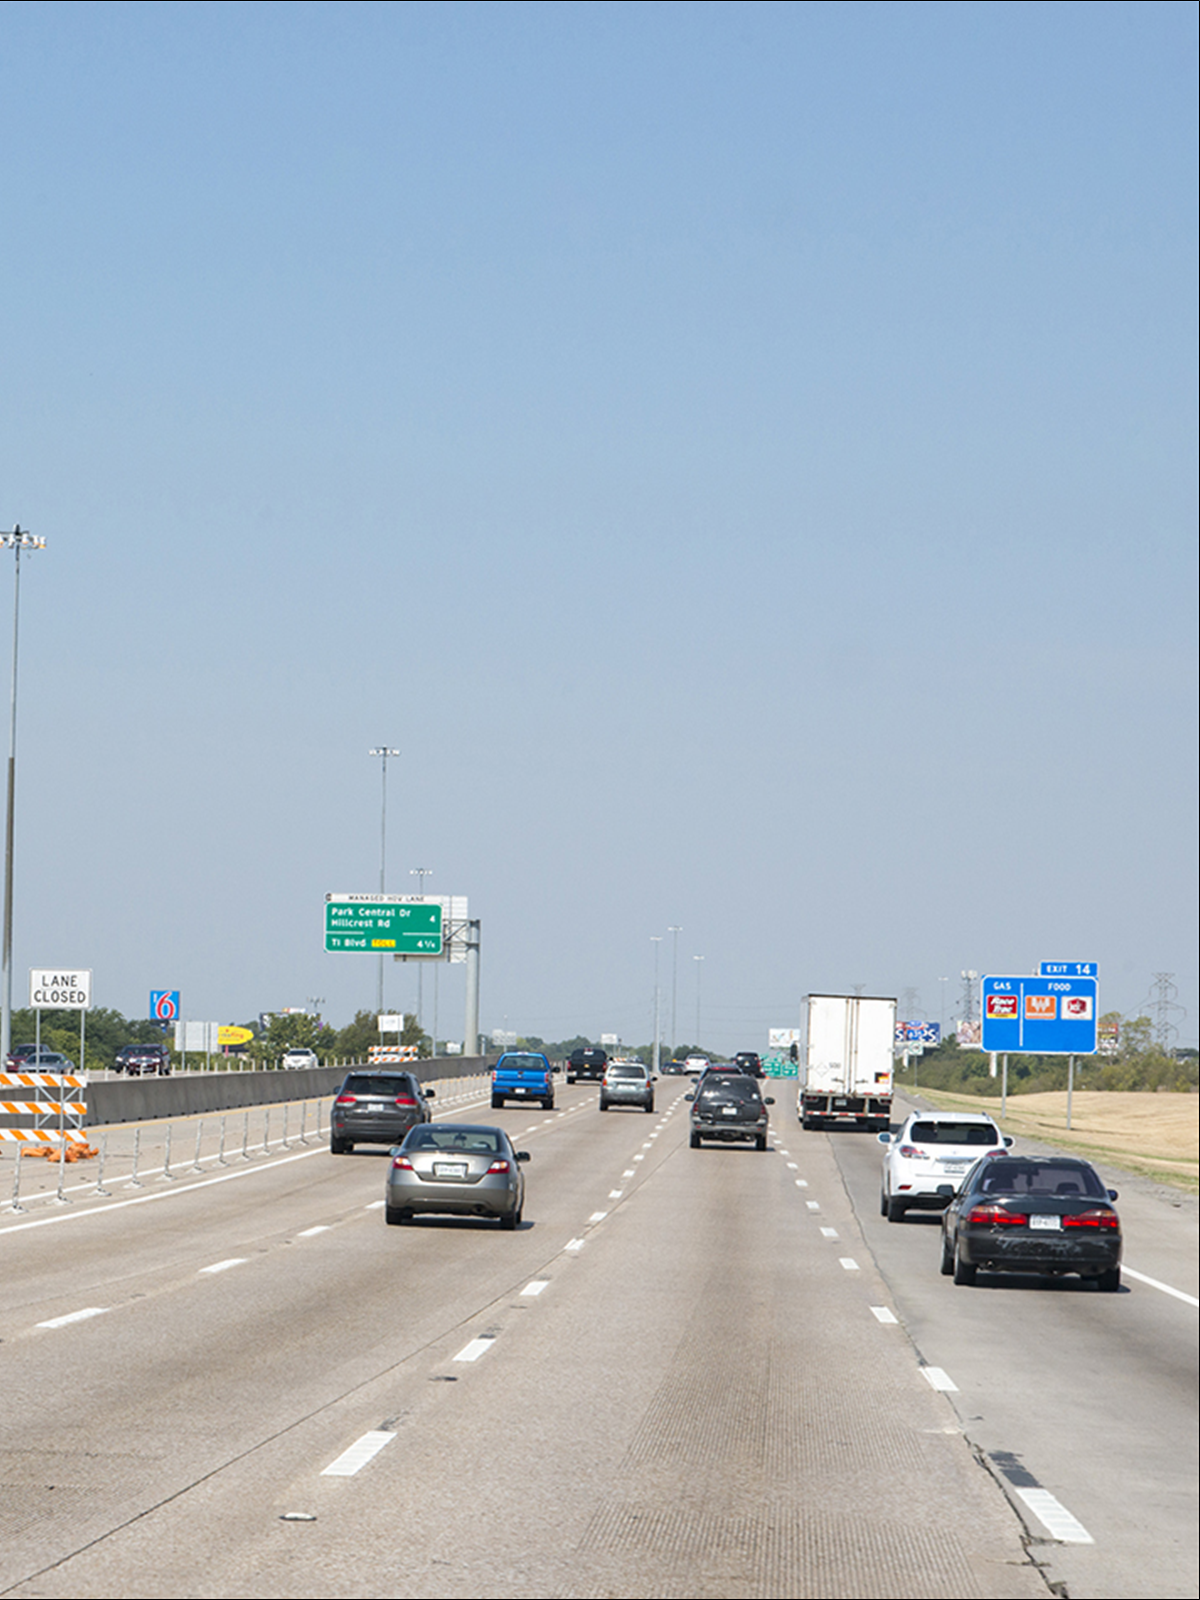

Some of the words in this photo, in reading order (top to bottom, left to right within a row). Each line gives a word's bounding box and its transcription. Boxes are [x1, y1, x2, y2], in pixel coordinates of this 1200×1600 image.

[331, 907, 353, 916] Park
[359, 908, 395, 917] Central
[400, 909, 411, 917] Dr
[331, 919, 373, 928] Hillcrest
[378, 920, 390, 928] Rd
[429, 915, 435, 923] 4
[344, 939, 366, 947] Blvd
[1046, 965, 1067, 973] EXIT
[1076, 964, 1091, 975] 14
[41, 975, 78, 988] LANE
[993, 982, 1012, 990] GAS
[1048, 983, 1071, 991] FOOD
[33, 990, 87, 1004] CLOSED
[155, 991, 176, 1019] 6
